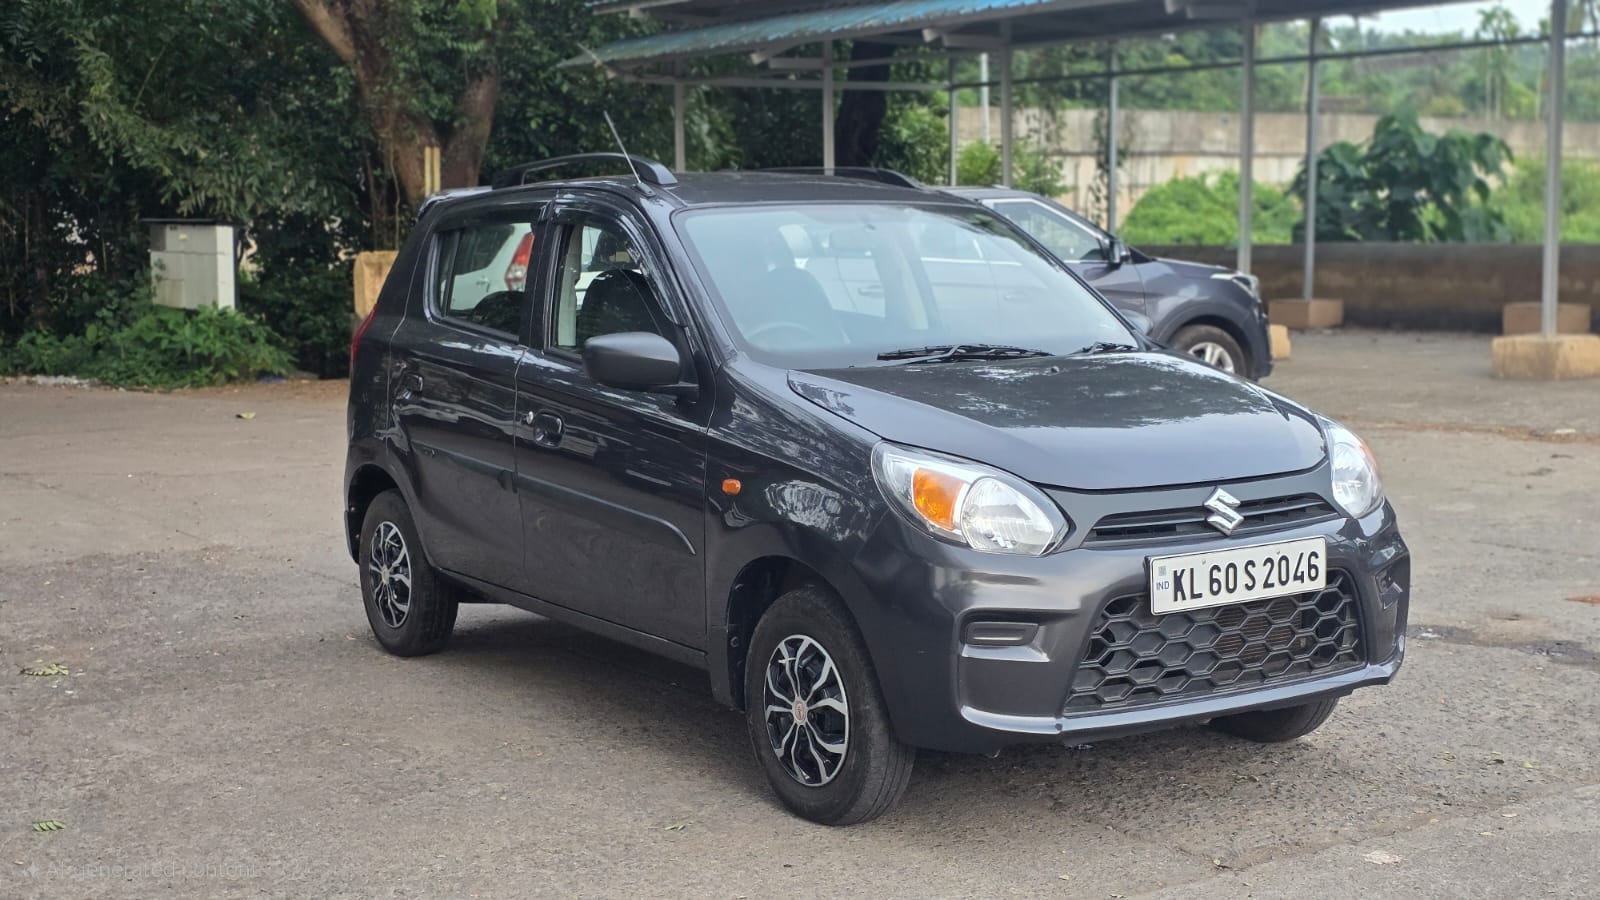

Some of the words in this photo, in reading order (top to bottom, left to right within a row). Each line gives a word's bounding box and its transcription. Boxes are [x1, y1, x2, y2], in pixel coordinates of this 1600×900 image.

[1156, 580, 1170, 591] IND
[1173, 568, 1203, 602] KL
[1209, 562, 1238, 596] 60
[1244, 559, 1257, 592] S
[1262, 551, 1320, 589] 2046
